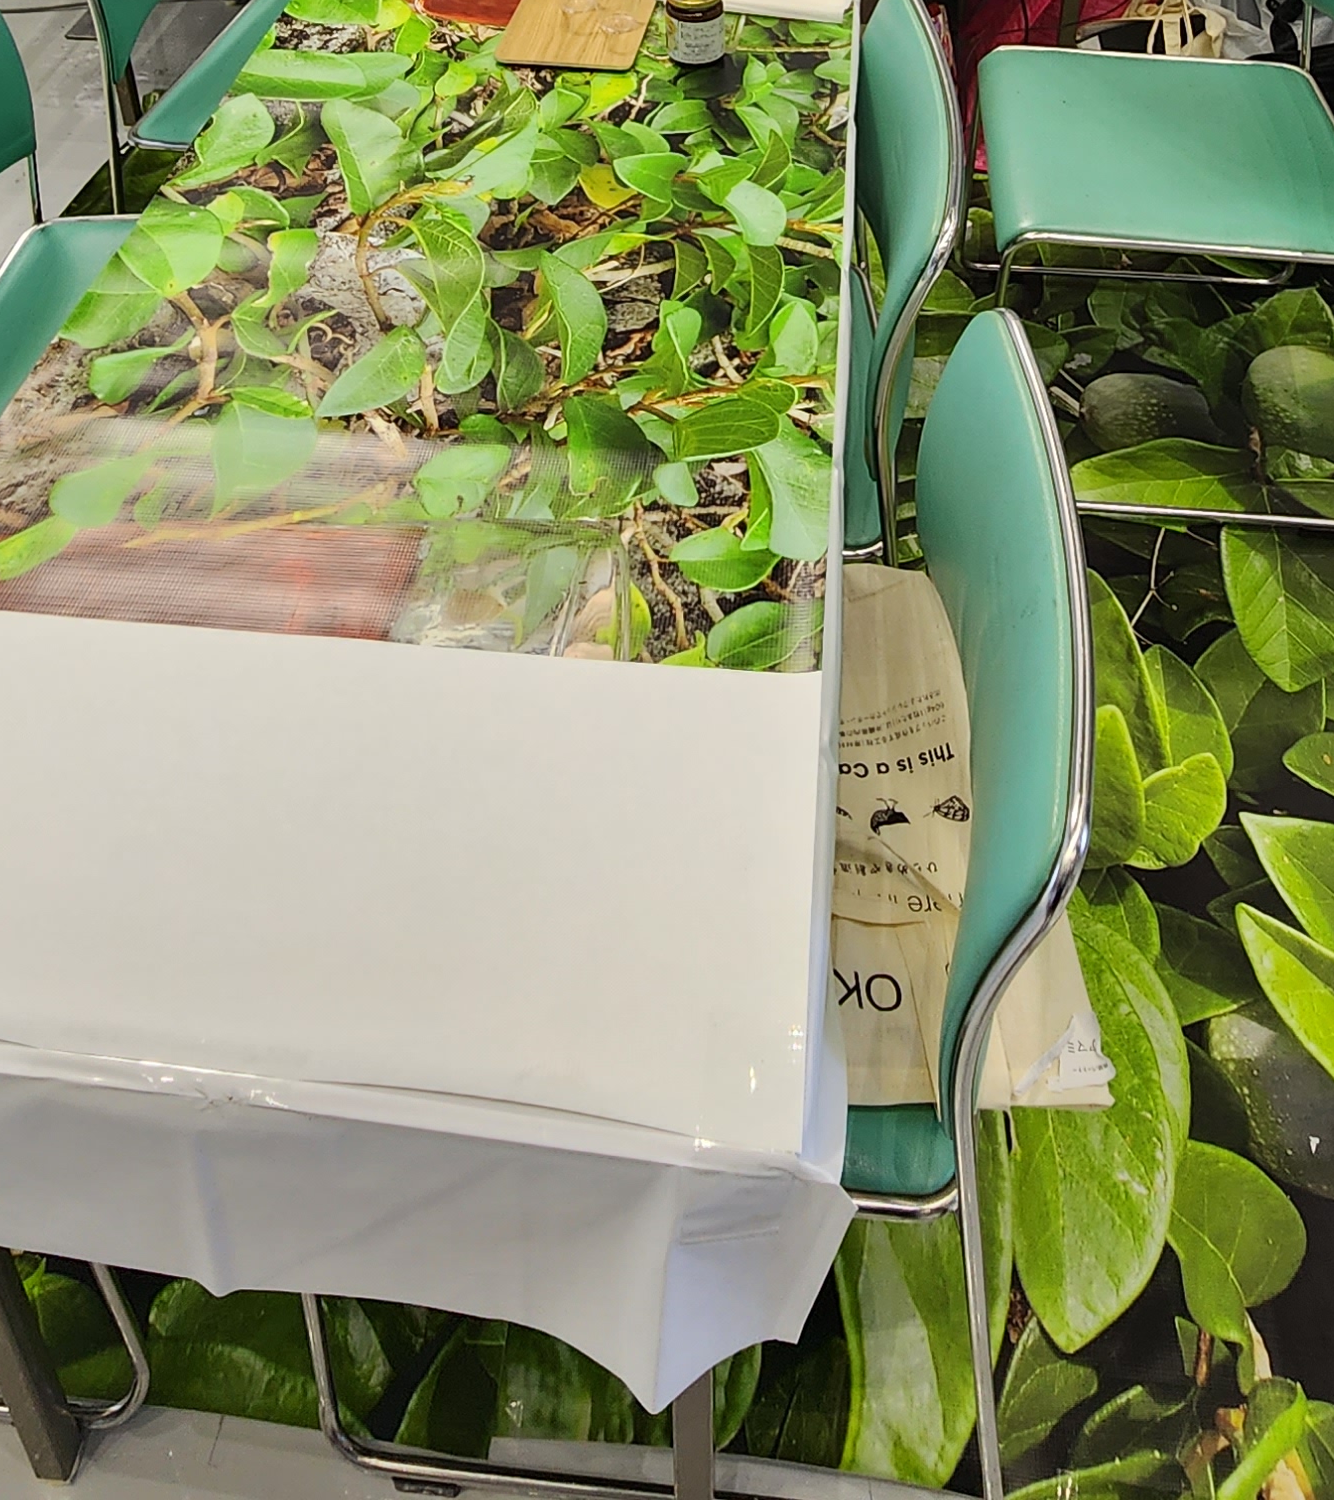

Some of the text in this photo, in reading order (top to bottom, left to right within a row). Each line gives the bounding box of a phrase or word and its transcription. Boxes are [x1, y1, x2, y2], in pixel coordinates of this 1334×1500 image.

[896, 756, 914, 774] is
[918, 741, 955, 767] This
[876, 762, 890, 775] a
[833, 967, 902, 1012] OK
